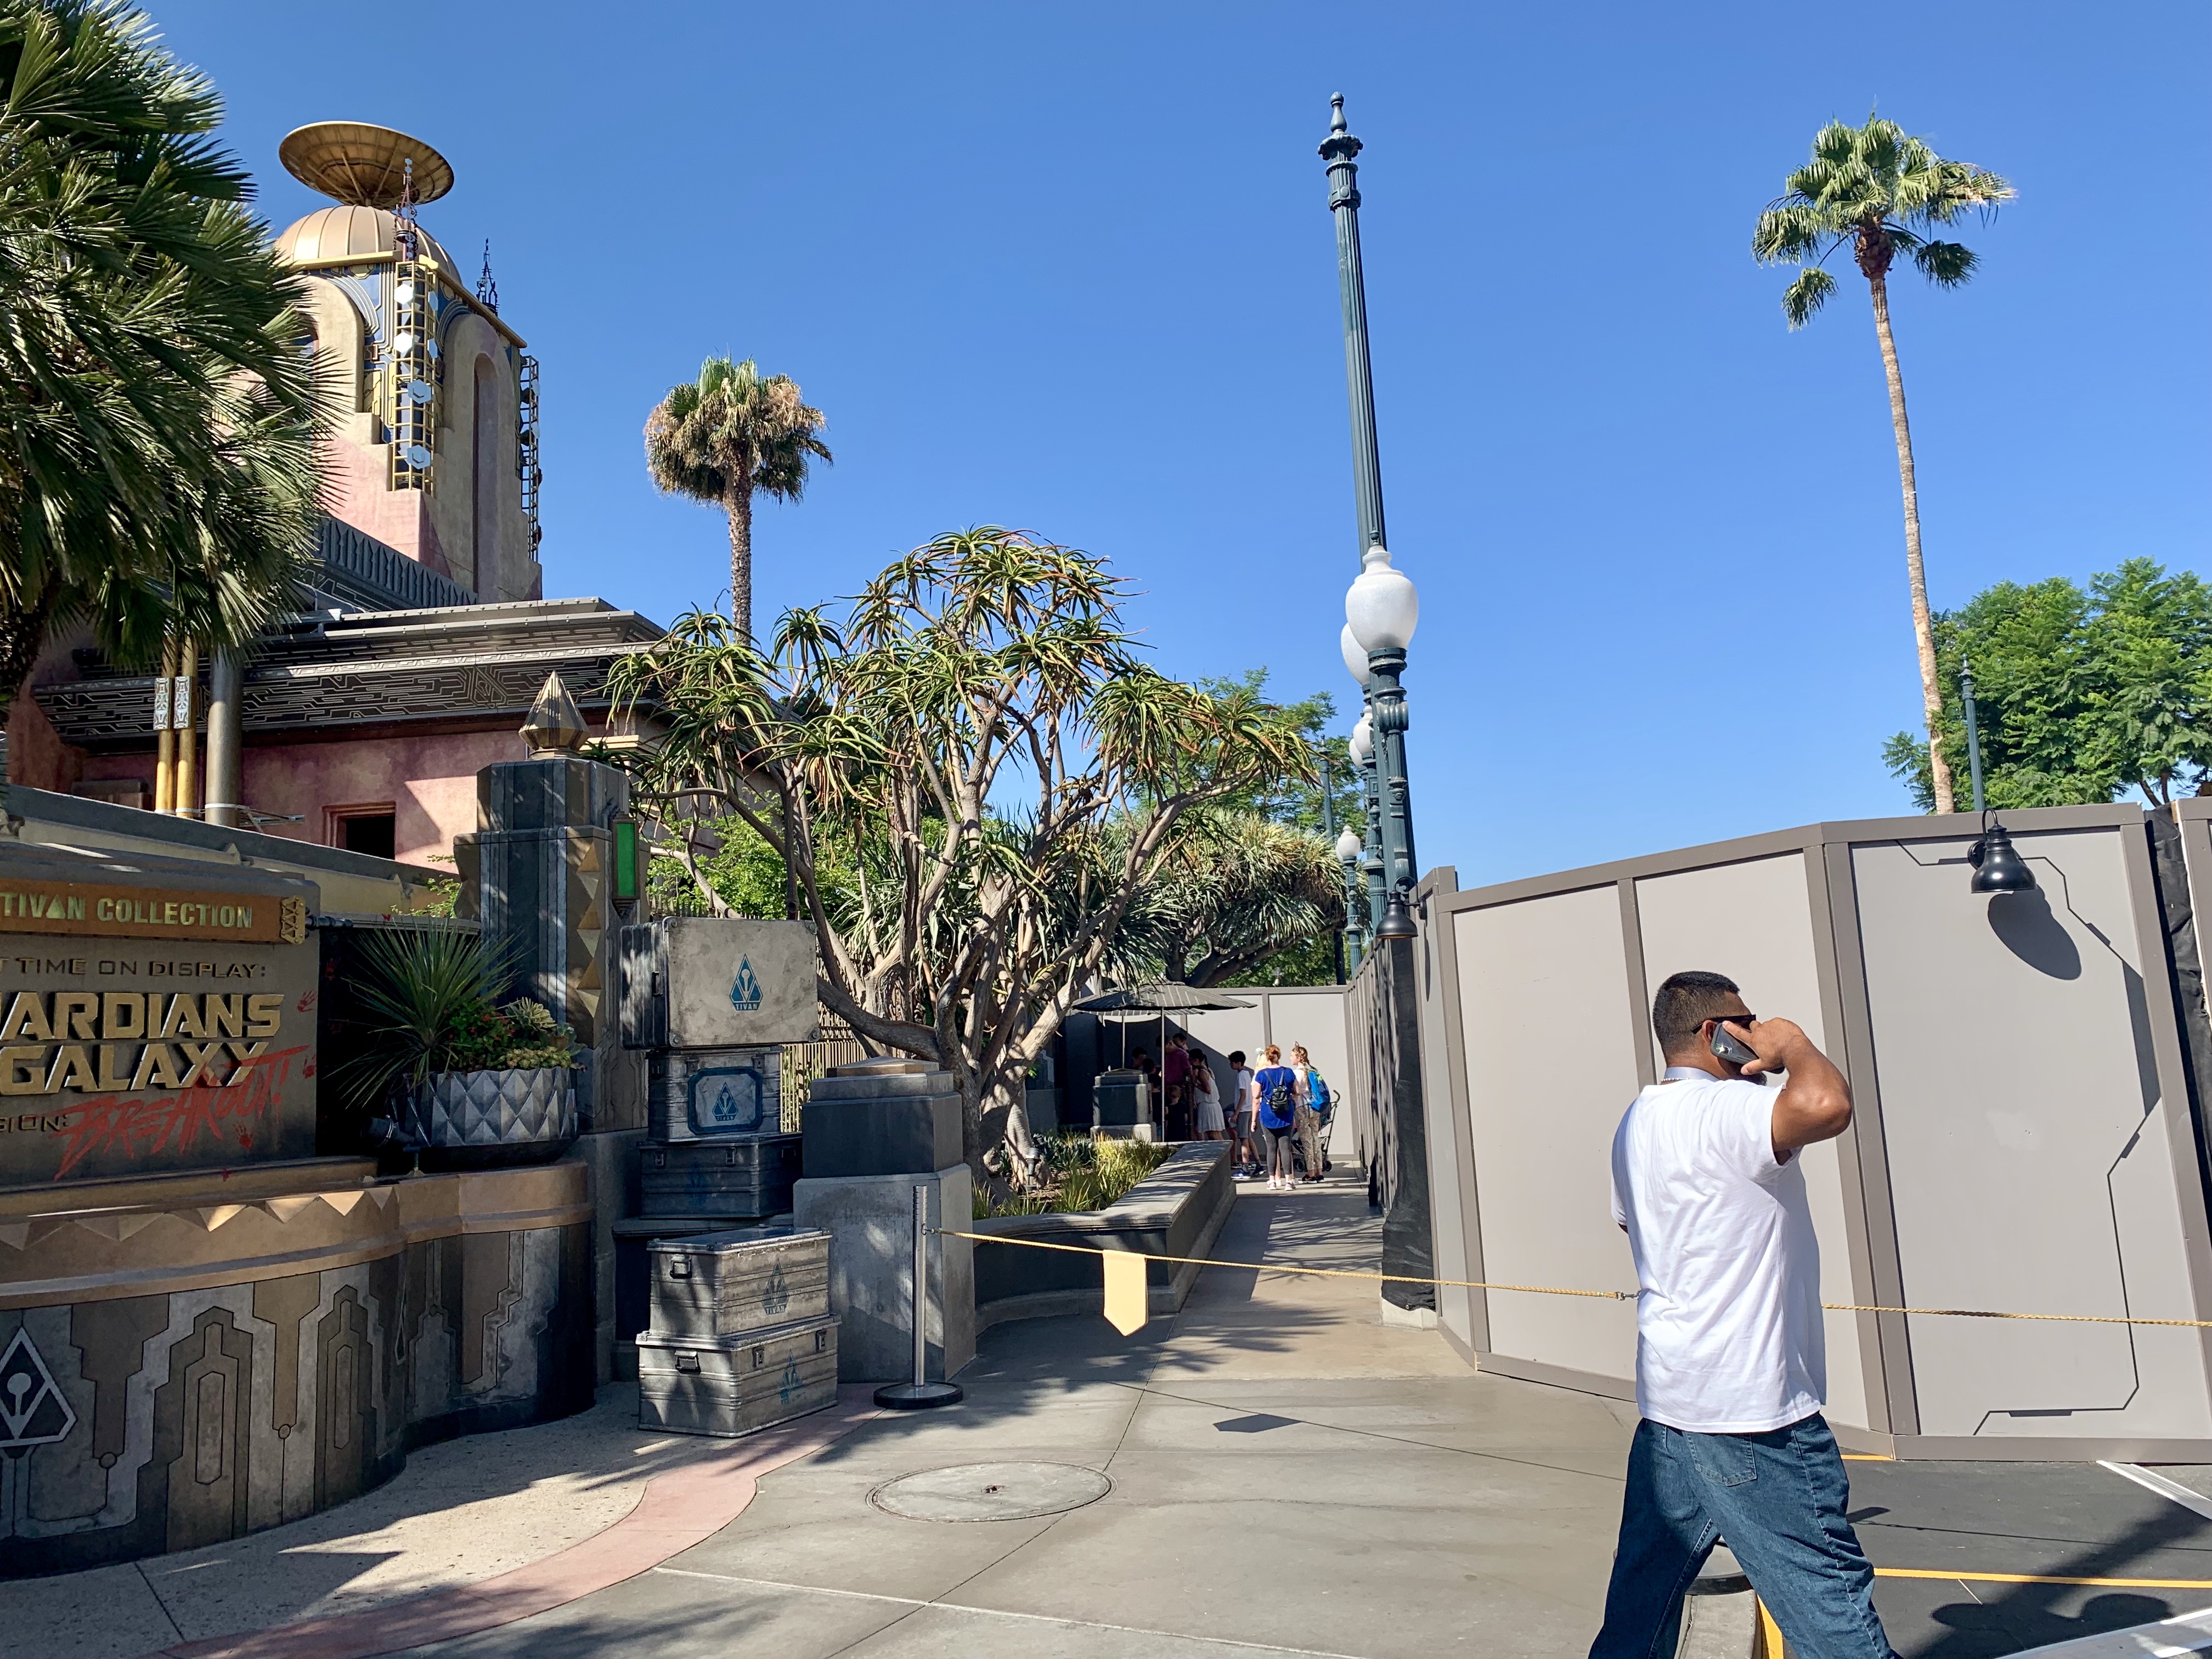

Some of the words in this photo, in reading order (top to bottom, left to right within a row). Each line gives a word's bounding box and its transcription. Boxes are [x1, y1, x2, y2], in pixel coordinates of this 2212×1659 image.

[0, 893, 85, 920] TIVAN
[97, 898, 252, 928] COLLECTION
[16, 957, 87, 974] TIME
[99, 960, 137, 975] ON
[149, 961, 266, 978] DISPLAY:
[0, 992, 285, 1041] ARDIANS
[0, 1042, 269, 1095] GALAXY
[44, 1045, 309, 1181] BREAKOUT!
[766, 1306, 785, 1314] TIVAN
